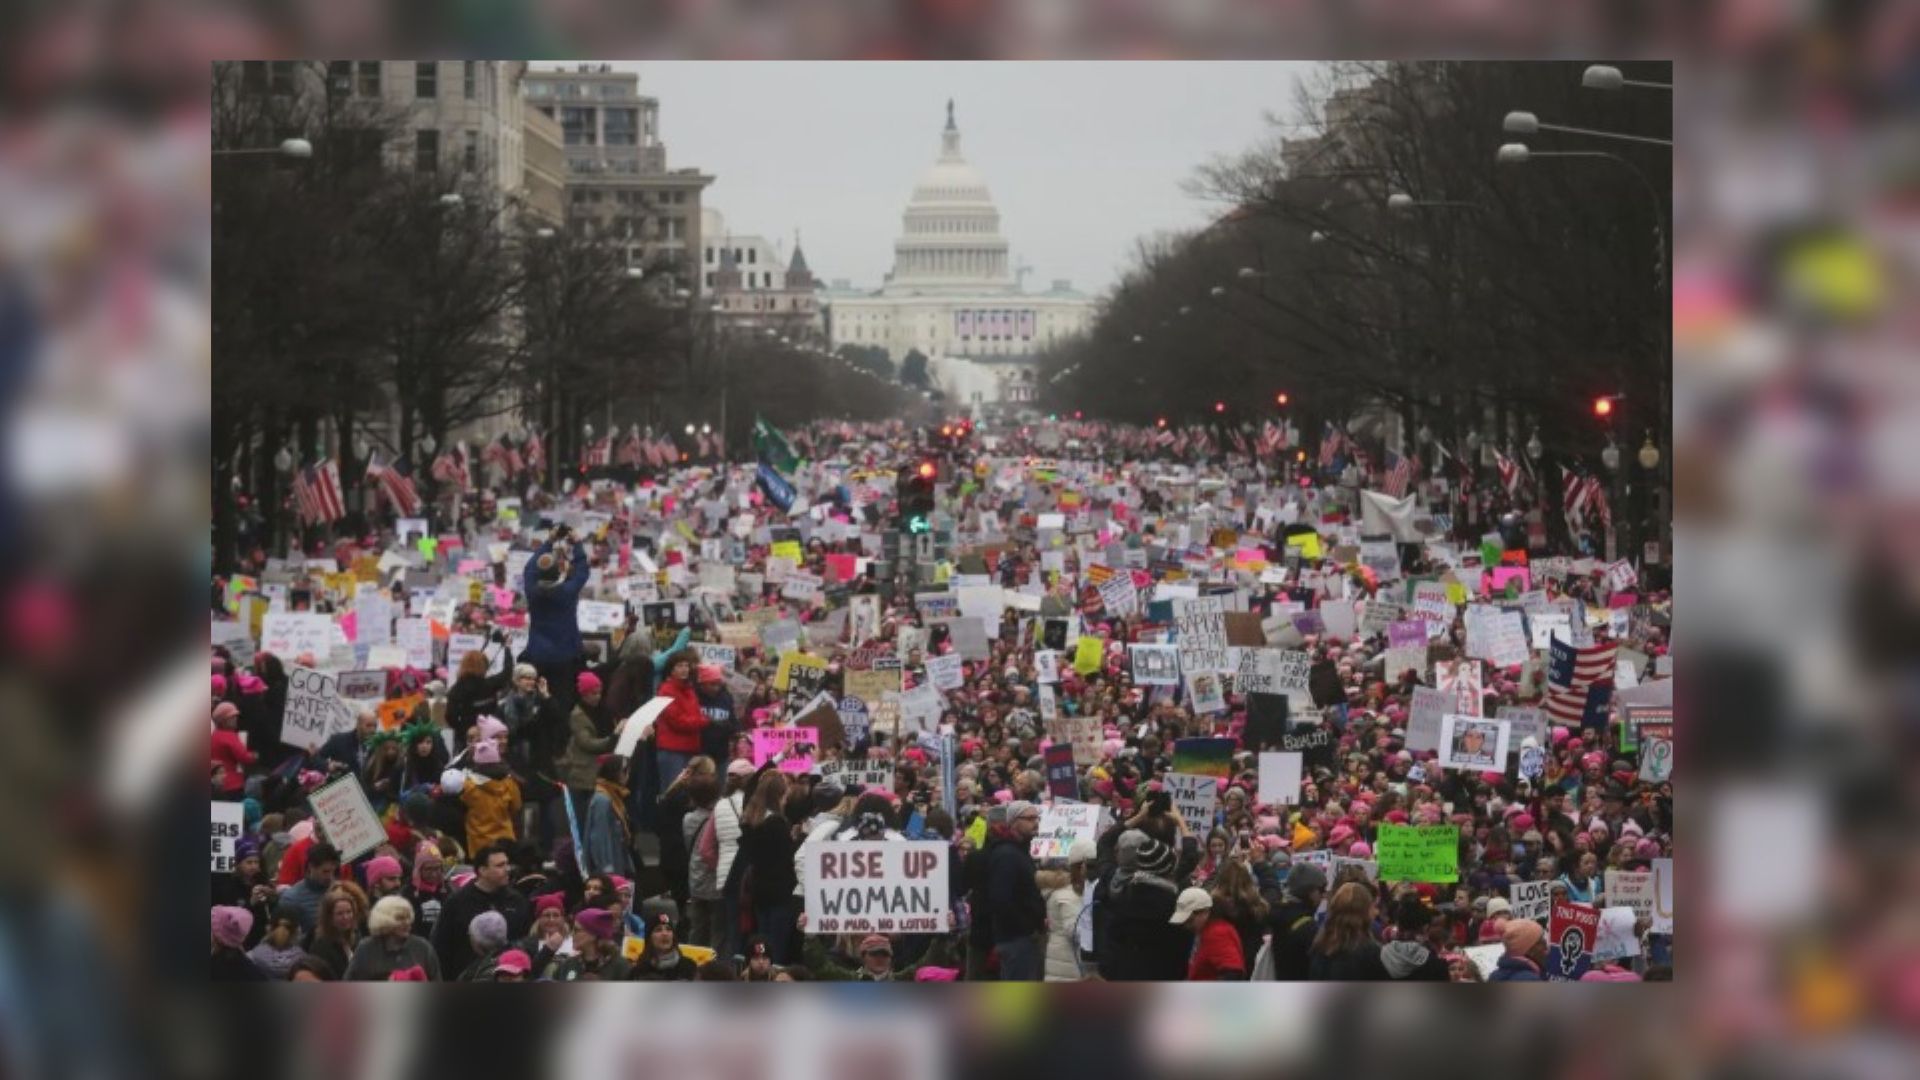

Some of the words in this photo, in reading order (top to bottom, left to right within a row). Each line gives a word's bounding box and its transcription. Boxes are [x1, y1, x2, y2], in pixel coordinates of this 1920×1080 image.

[790, 663, 825, 679] STOP
[291, 668, 336, 699] GOD
[762, 730, 808, 739] WOMENS
[1283, 732, 1328, 750] EQUALITY
[1175, 788, 1196, 801] I'M
[820, 850, 884, 879] RISE
[903, 850, 938, 879] UP
[820, 885, 939, 915] WOMAN.
[1518, 882, 1549, 902] LOVE
[818, 919, 839, 931] NO
[843, 919, 875, 933] MUD,
[878, 918, 894, 931] NO
[899, 918, 938, 931] LOTUS
